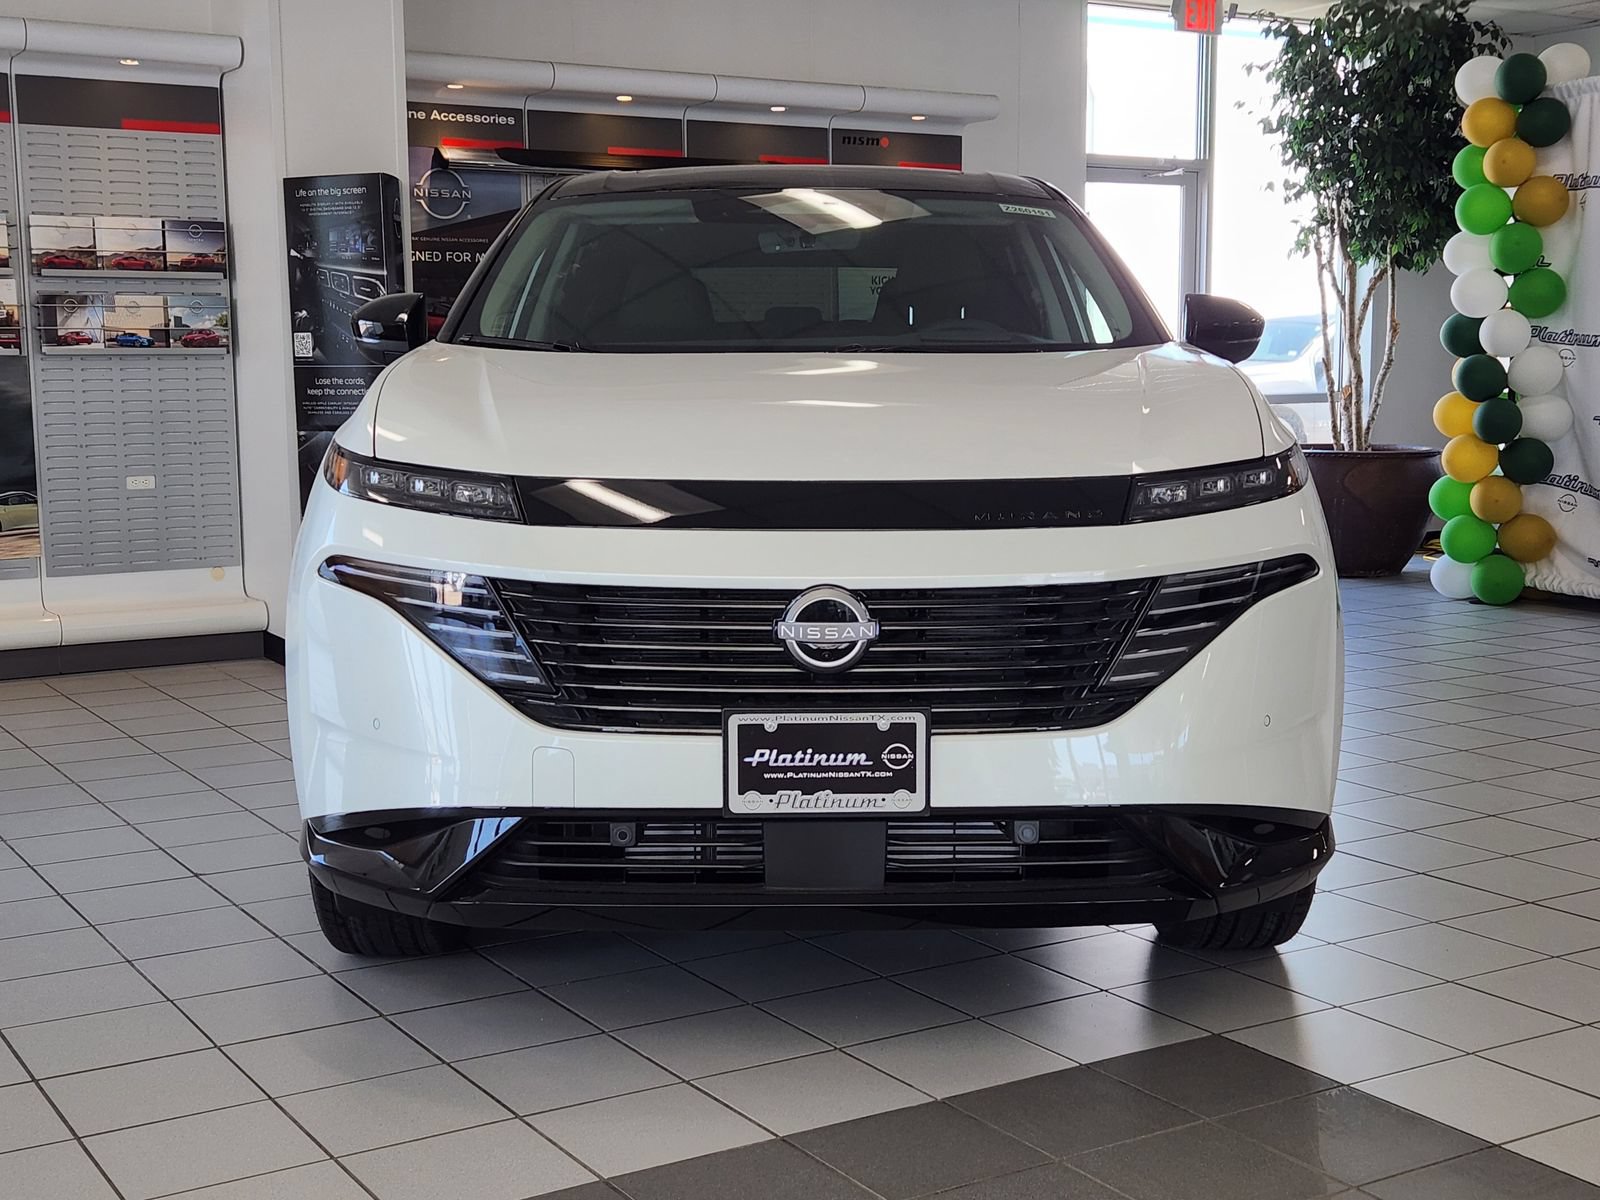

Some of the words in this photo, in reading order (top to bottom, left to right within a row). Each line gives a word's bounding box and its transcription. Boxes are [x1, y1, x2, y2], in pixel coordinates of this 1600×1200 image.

[408, 111, 426, 120] ne
[430, 110, 516, 125] Accessories
[842, 136, 890, 148] nismo
[295, 190, 307, 198] Life
[308, 189, 317, 197] on
[317, 188, 330, 197] the
[330, 187, 341, 197] big
[342, 186, 367, 195] screen
[413, 187, 472, 199] NISSAN
[446, 251, 472, 263] FOR
[315, 377, 331, 385] Lose
[332, 377, 344, 385] the
[344, 377, 366, 386] cords,
[307, 388, 323, 396] keep
[324, 387, 336, 396] the
[781, 625, 874, 639] NISSAN
[738, 714, 916, 723] www.PlatinumNissanTX.com
[743, 748, 874, 767] Platinum
[775, 793, 884, 809] Platinum
